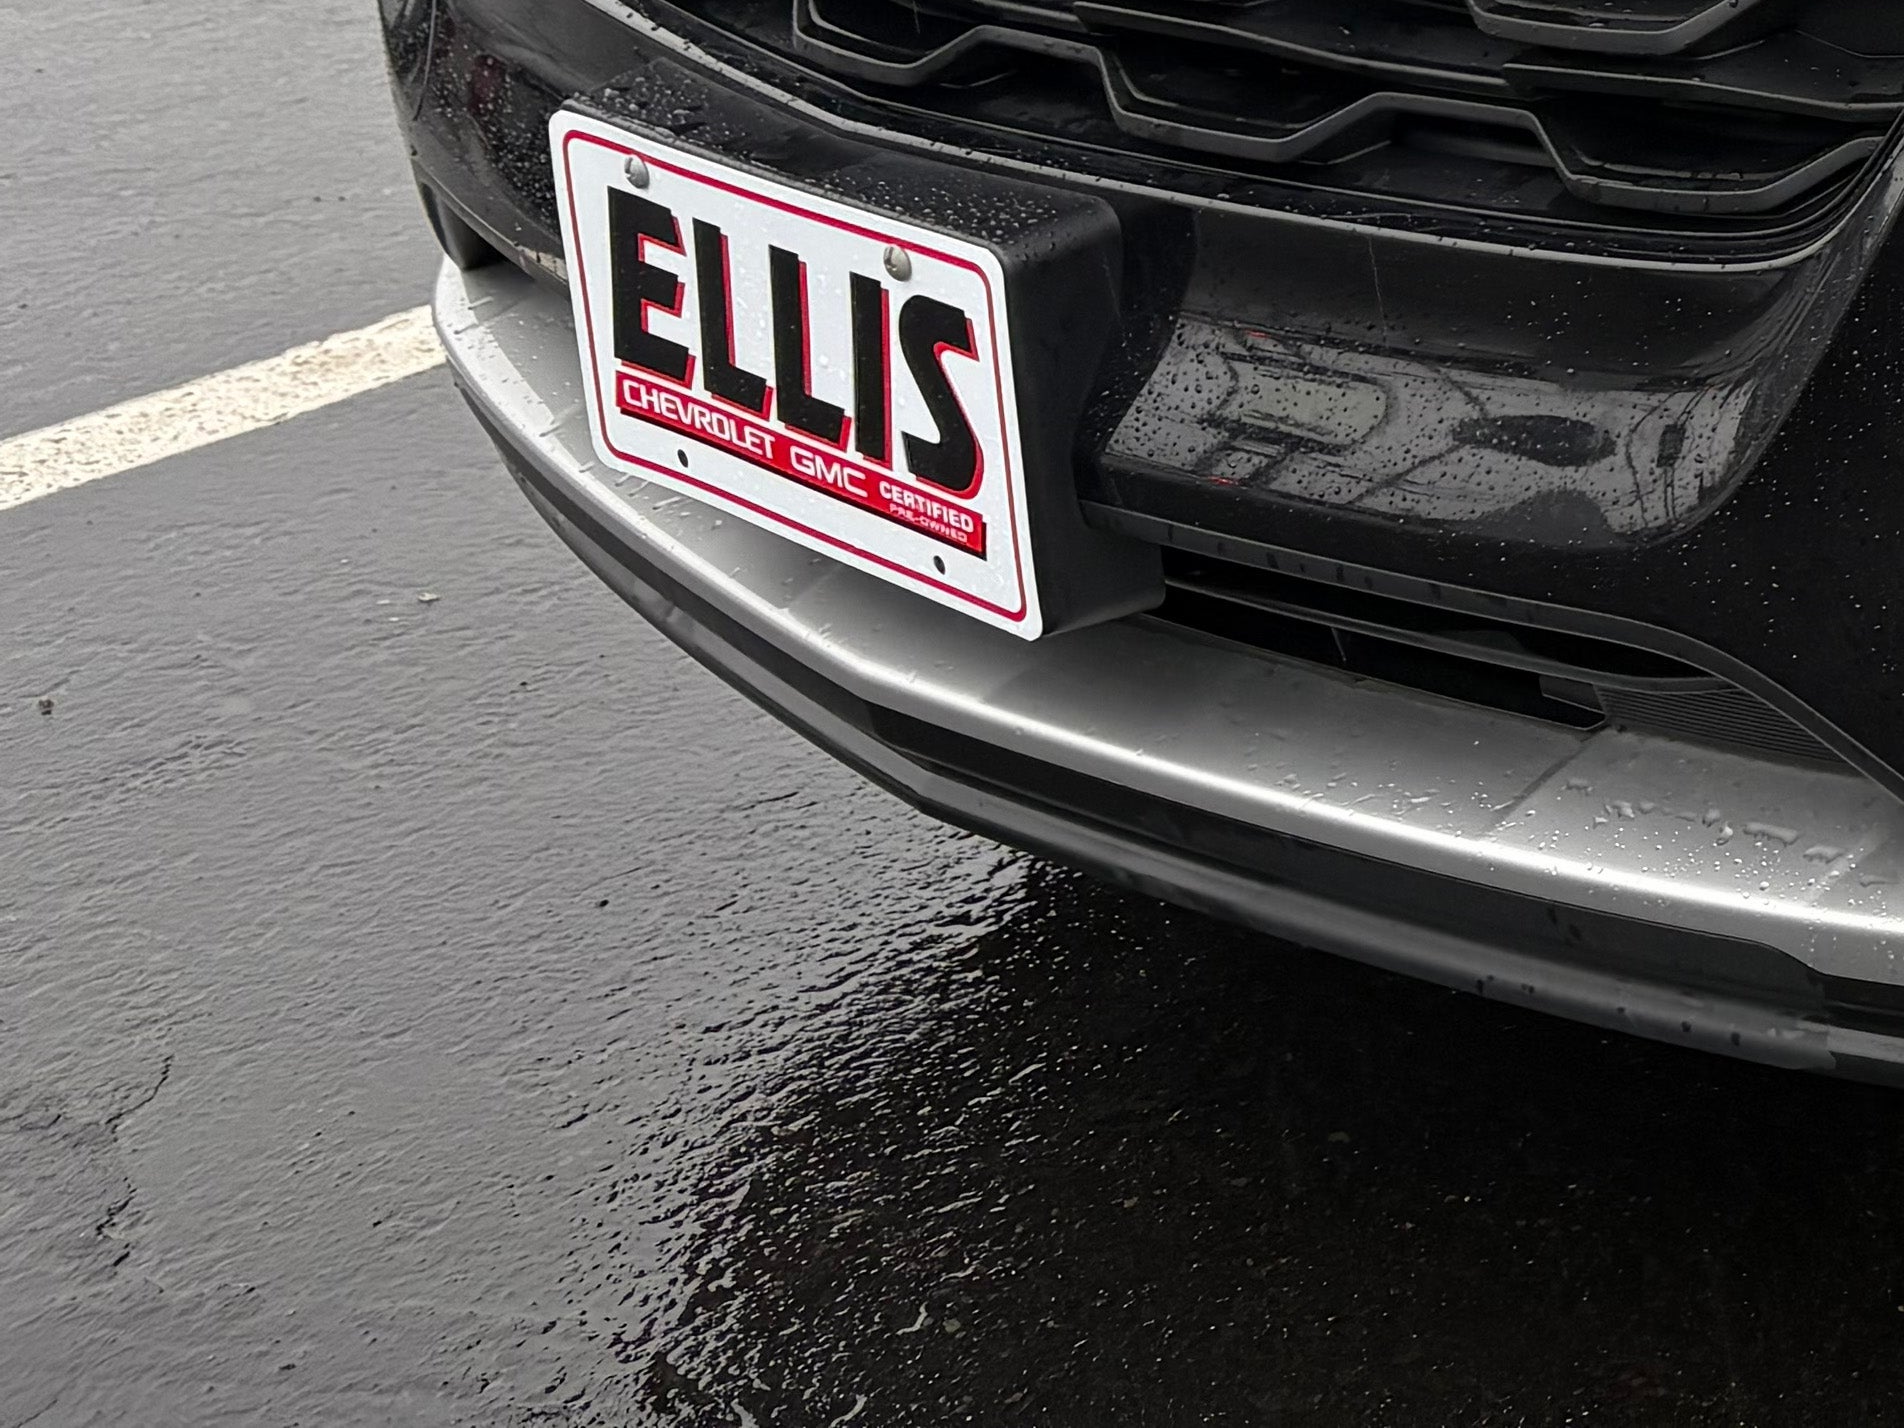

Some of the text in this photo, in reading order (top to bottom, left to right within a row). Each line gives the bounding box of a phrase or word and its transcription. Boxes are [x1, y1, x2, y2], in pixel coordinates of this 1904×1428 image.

[607, 186, 985, 500] ELLIS
[622, 379, 975, 534] CHEVROLET GMC CERTIFIED
[888, 502, 968, 544] PRE-OWNED
